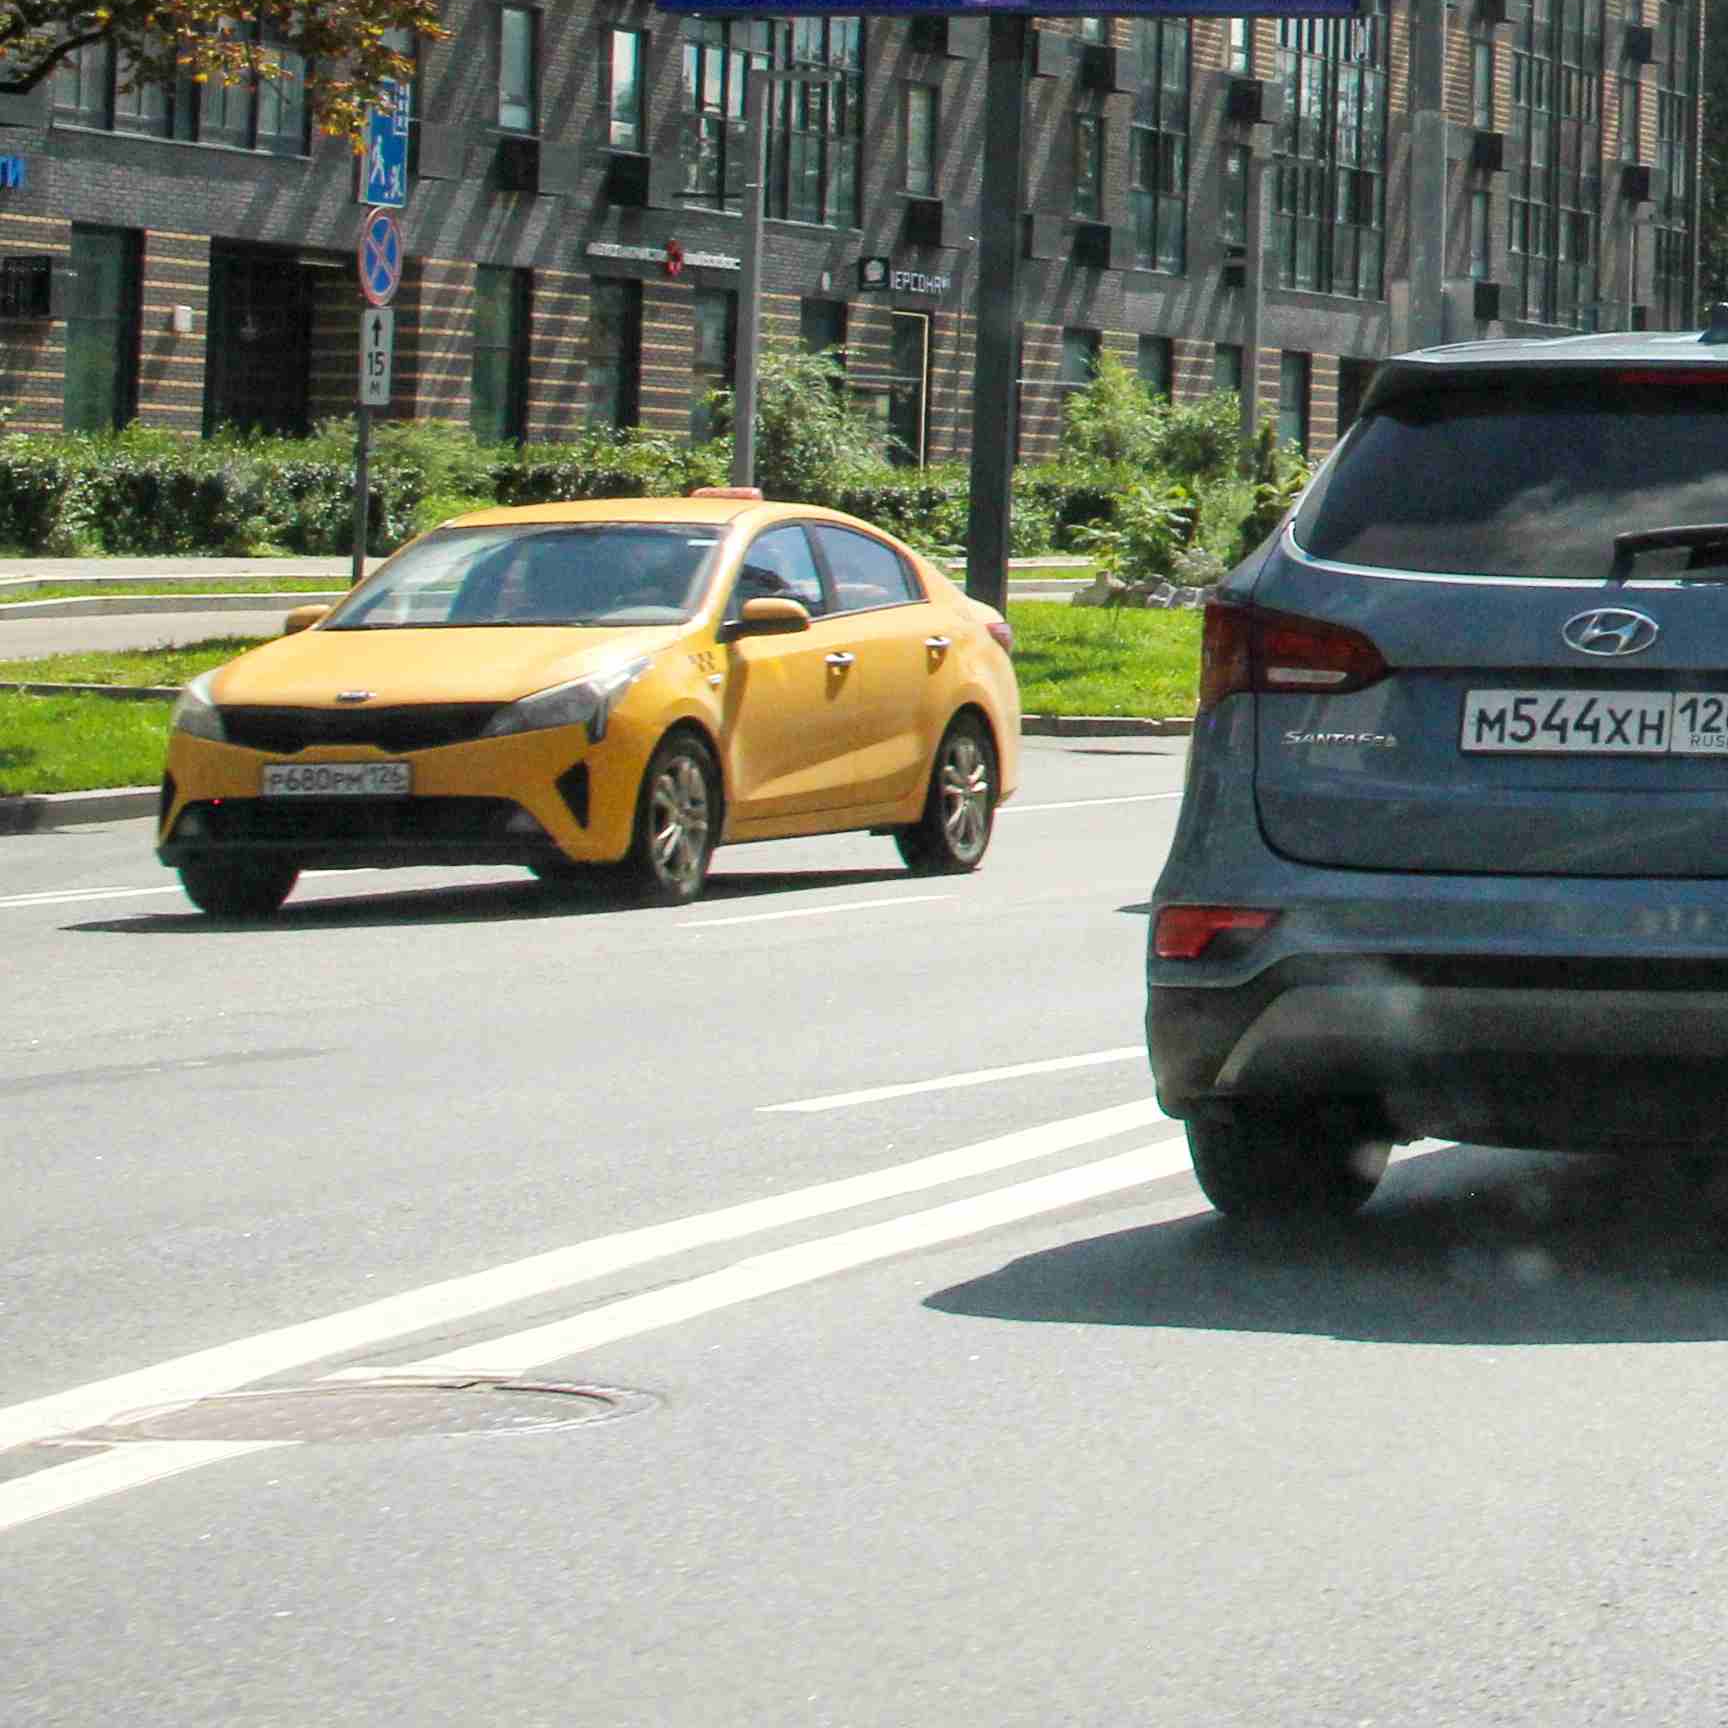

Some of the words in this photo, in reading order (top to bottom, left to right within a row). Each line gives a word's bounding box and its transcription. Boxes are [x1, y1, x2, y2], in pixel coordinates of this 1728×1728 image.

[368, 351, 385, 377] 15
[1475, 697, 1663, 745] М544ХН
[1690, 735, 1727, 748] RUS
